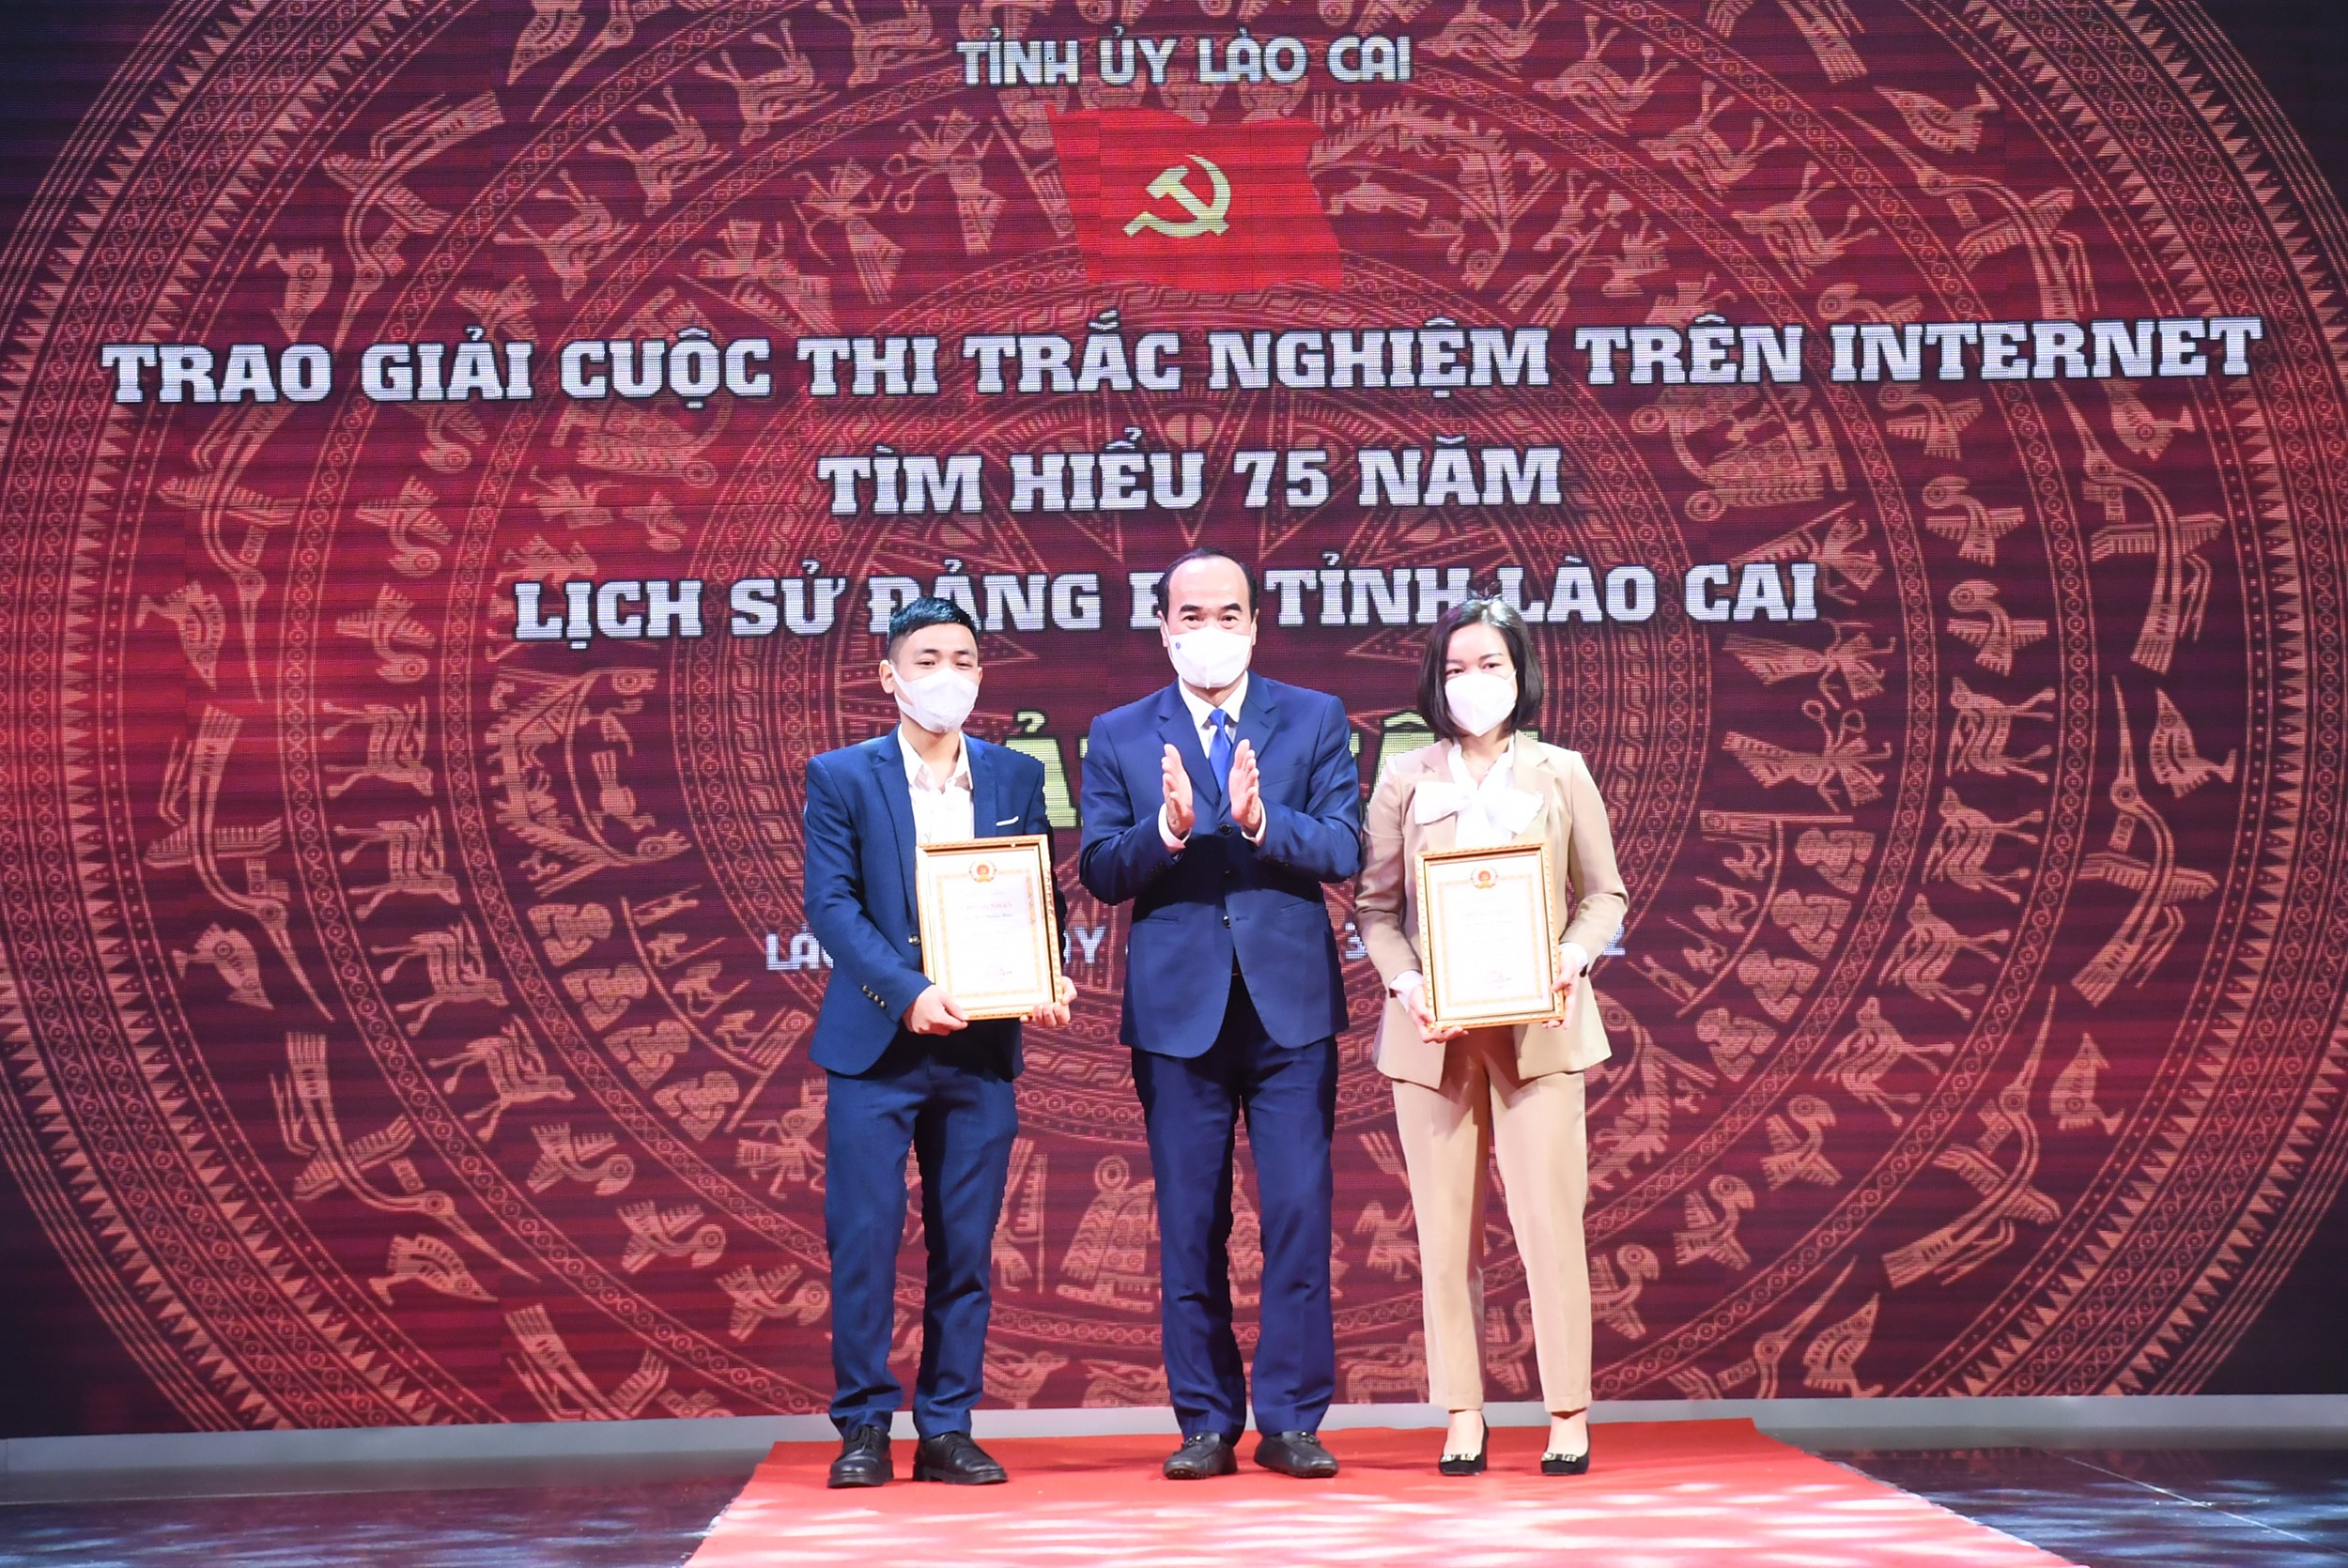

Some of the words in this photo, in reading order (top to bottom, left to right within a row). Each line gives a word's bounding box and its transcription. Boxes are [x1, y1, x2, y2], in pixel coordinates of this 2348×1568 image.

[957, 27, 1078, 85] TỈNH
[1100, 26, 1178, 84] ỦY
[1197, 27, 1307, 83] LÀO
[1327, 34, 1412, 82] CAI
[102, 344, 332, 403] TRAO
[362, 326, 533, 401] GIẢI
[561, 329, 771, 407] CUỘC
[797, 335, 938, 395] THI
[964, 309, 1184, 392] TRẮC
[1209, 317, 1551, 398] NGHIỆM
[1575, 315, 1802, 384] TRÊN
[1831, 317, 2263, 382] INTERNET
[819, 446, 981, 515] TÌM
[1011, 428, 1207, 511] HIỂU
[1233, 450, 1328, 506] 75
[1358, 436, 1562, 505] NĂM
[516, 579, 703, 649] LỊCH
[731, 559, 845, 636] SỬ
[1264, 552, 1471, 625] TỈNH
[1498, 556, 1656, 623] LÀO
[1684, 562, 1818, 620] CAI
